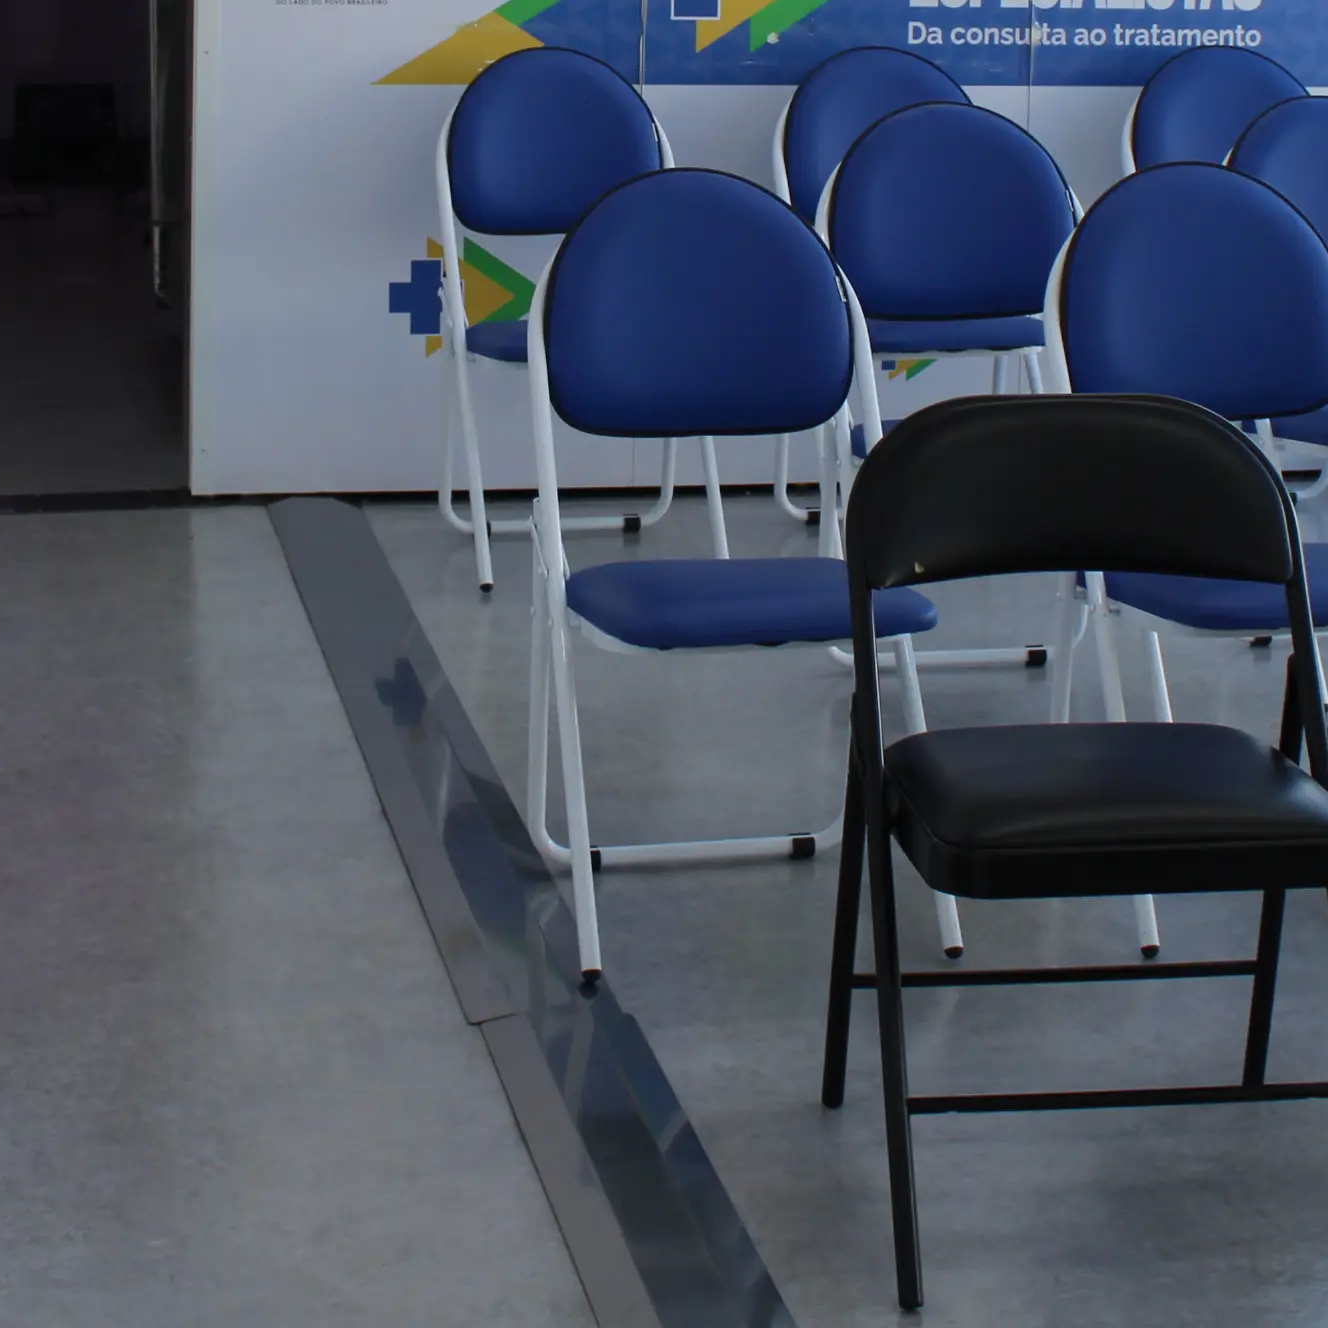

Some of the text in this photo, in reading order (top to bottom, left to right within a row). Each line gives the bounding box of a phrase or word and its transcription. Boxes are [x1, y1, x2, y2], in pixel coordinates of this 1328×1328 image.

[908, 21, 1262, 47] Da consuta ao tratamento
